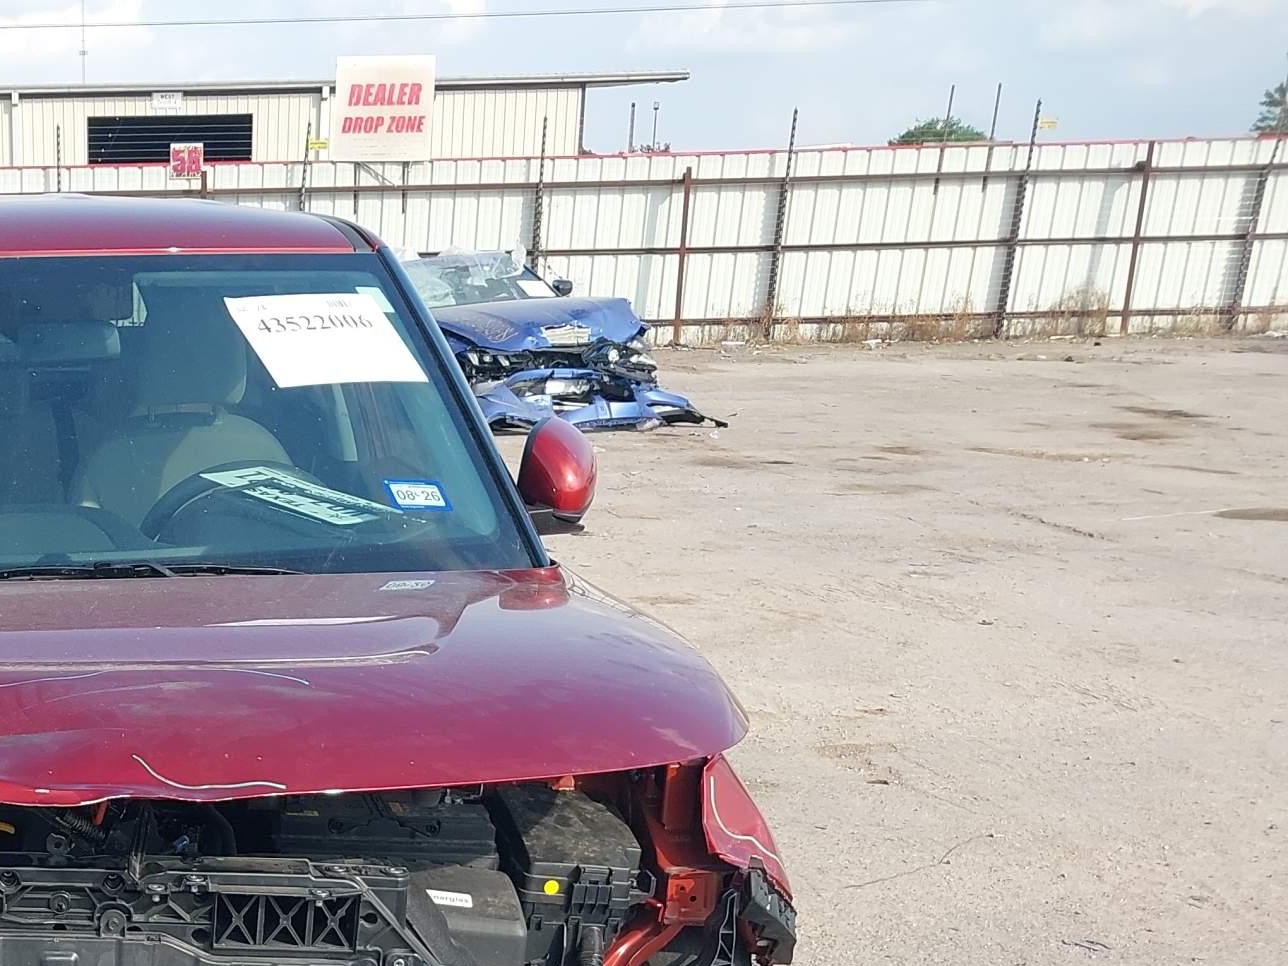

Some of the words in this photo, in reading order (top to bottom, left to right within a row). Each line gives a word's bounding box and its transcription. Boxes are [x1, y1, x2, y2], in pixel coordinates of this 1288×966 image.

[348, 83, 422, 106] DEALER
[342, 116, 385, 134] DROP
[386, 115, 426, 133] ZONE
[258, 314, 374, 333] 43522006
[396, 490, 416, 501] 08
[421, 490, 441, 502] 26
